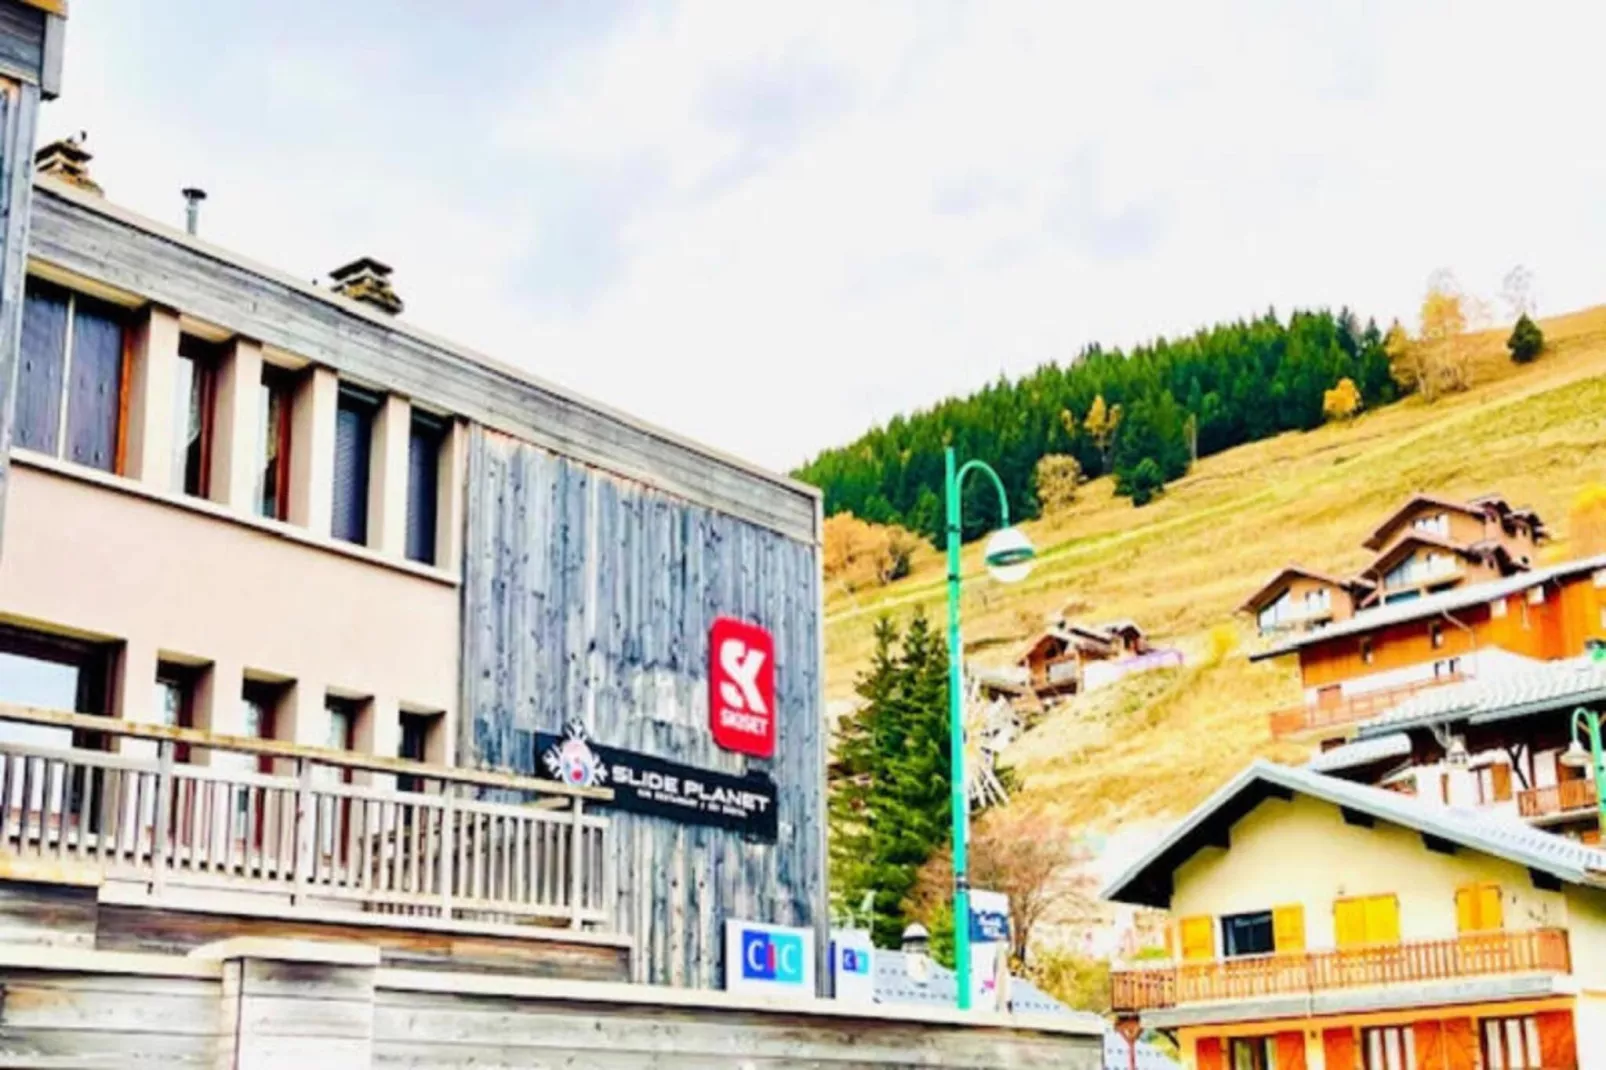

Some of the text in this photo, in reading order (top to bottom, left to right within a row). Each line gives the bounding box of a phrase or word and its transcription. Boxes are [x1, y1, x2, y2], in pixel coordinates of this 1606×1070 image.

[611, 765, 679, 794] SLIDE
[684, 779, 770, 812] PLANET
[747, 939, 797, 975] CIC
